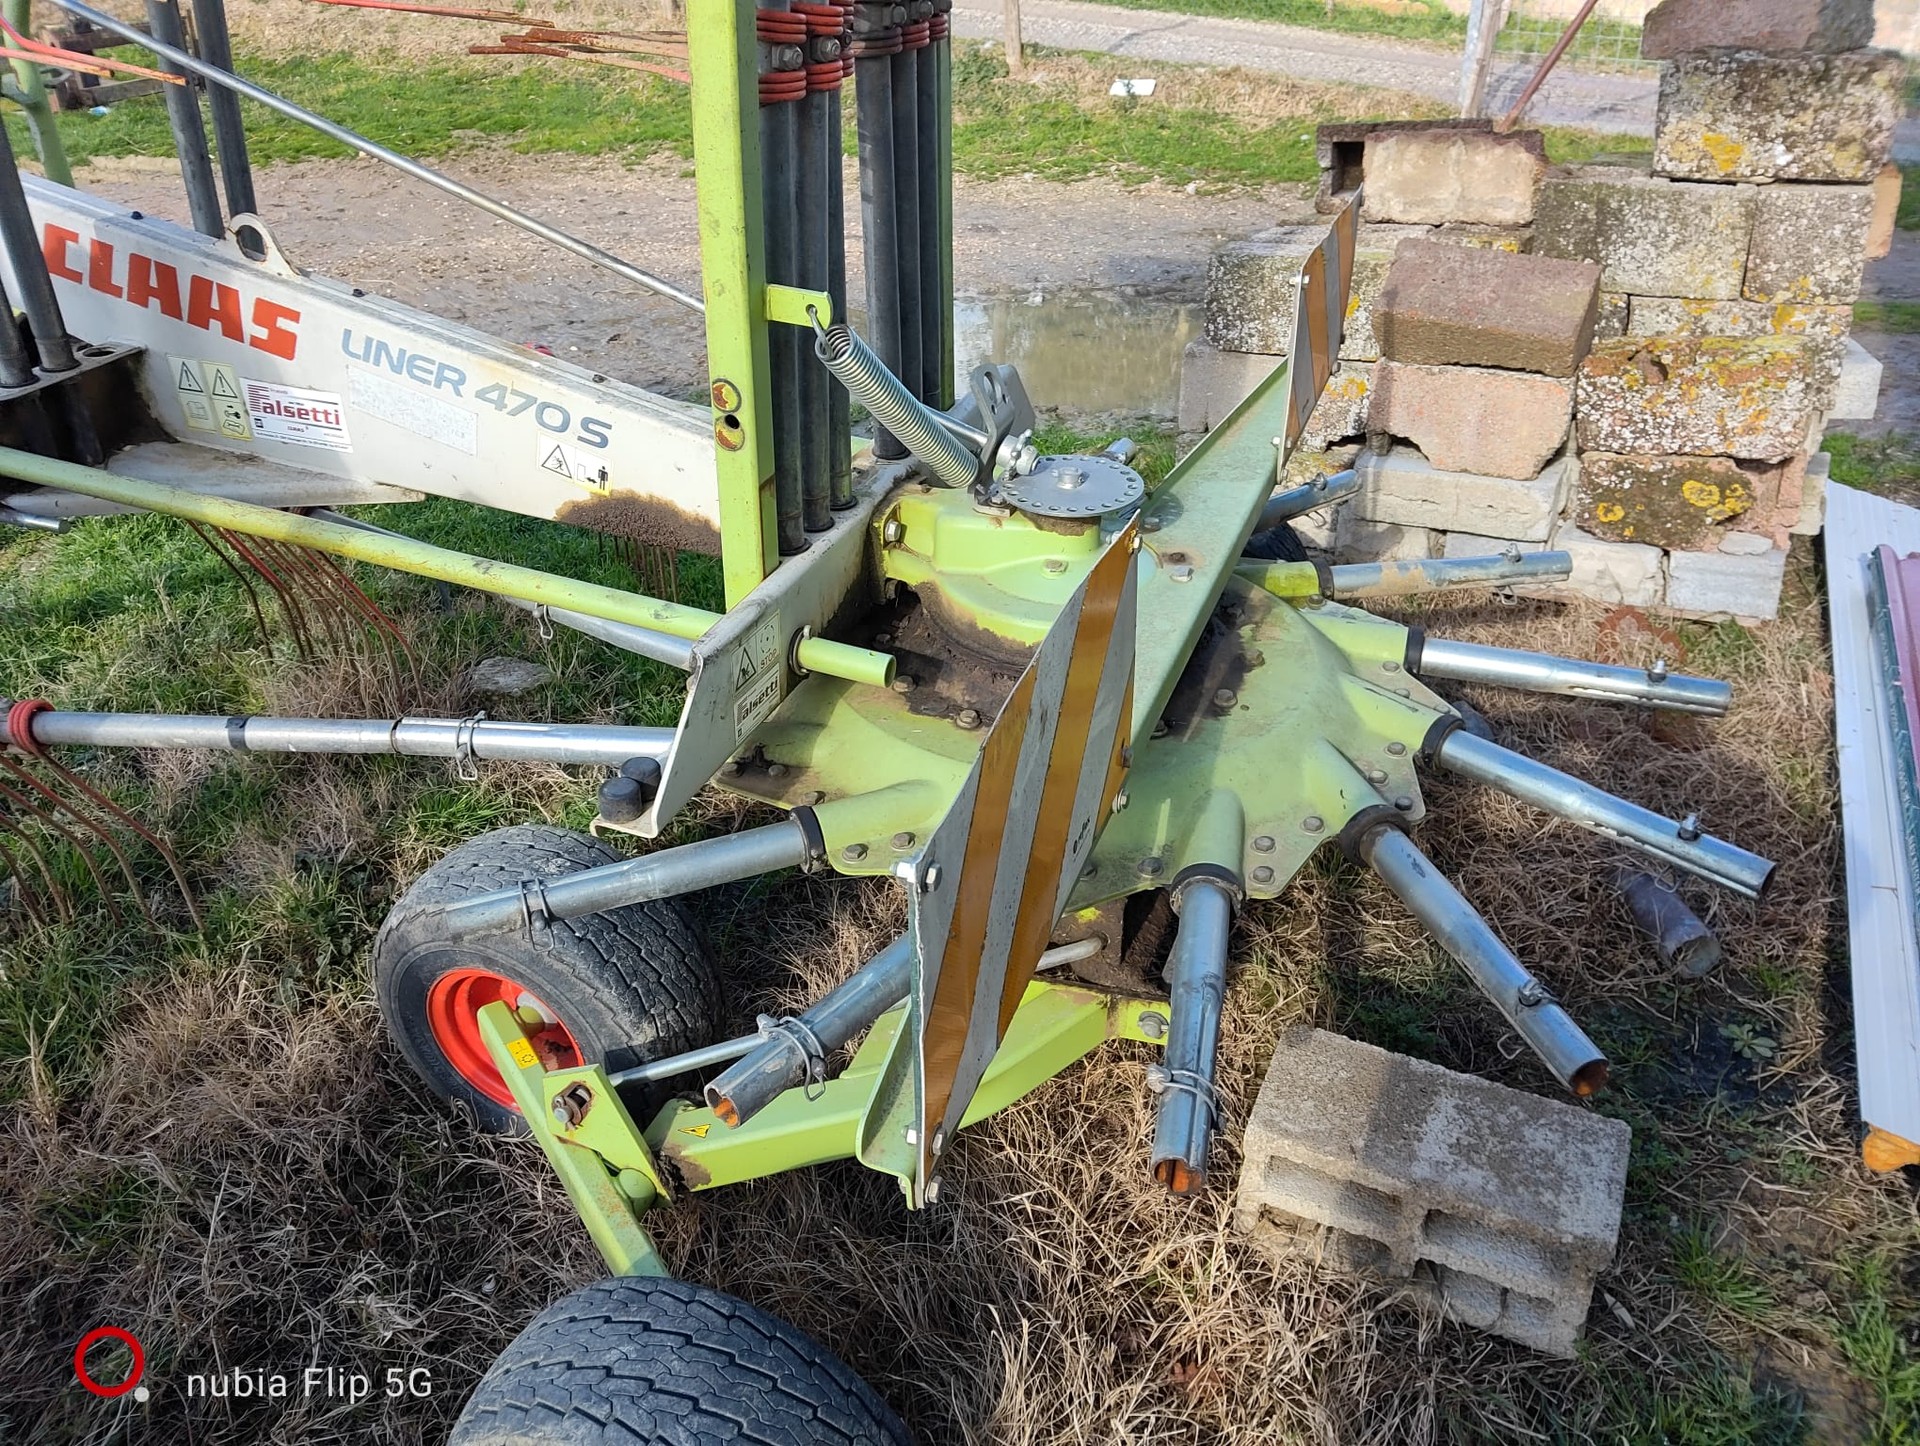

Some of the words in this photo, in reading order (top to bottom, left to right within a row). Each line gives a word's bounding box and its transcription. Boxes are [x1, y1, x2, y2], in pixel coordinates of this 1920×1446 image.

[43, 222, 301, 361] CLAAS
[341, 328, 467, 398] LINER
[474, 382, 571, 433] 470
[577, 416, 613, 449] S
[760, 648, 778, 670] STOP
